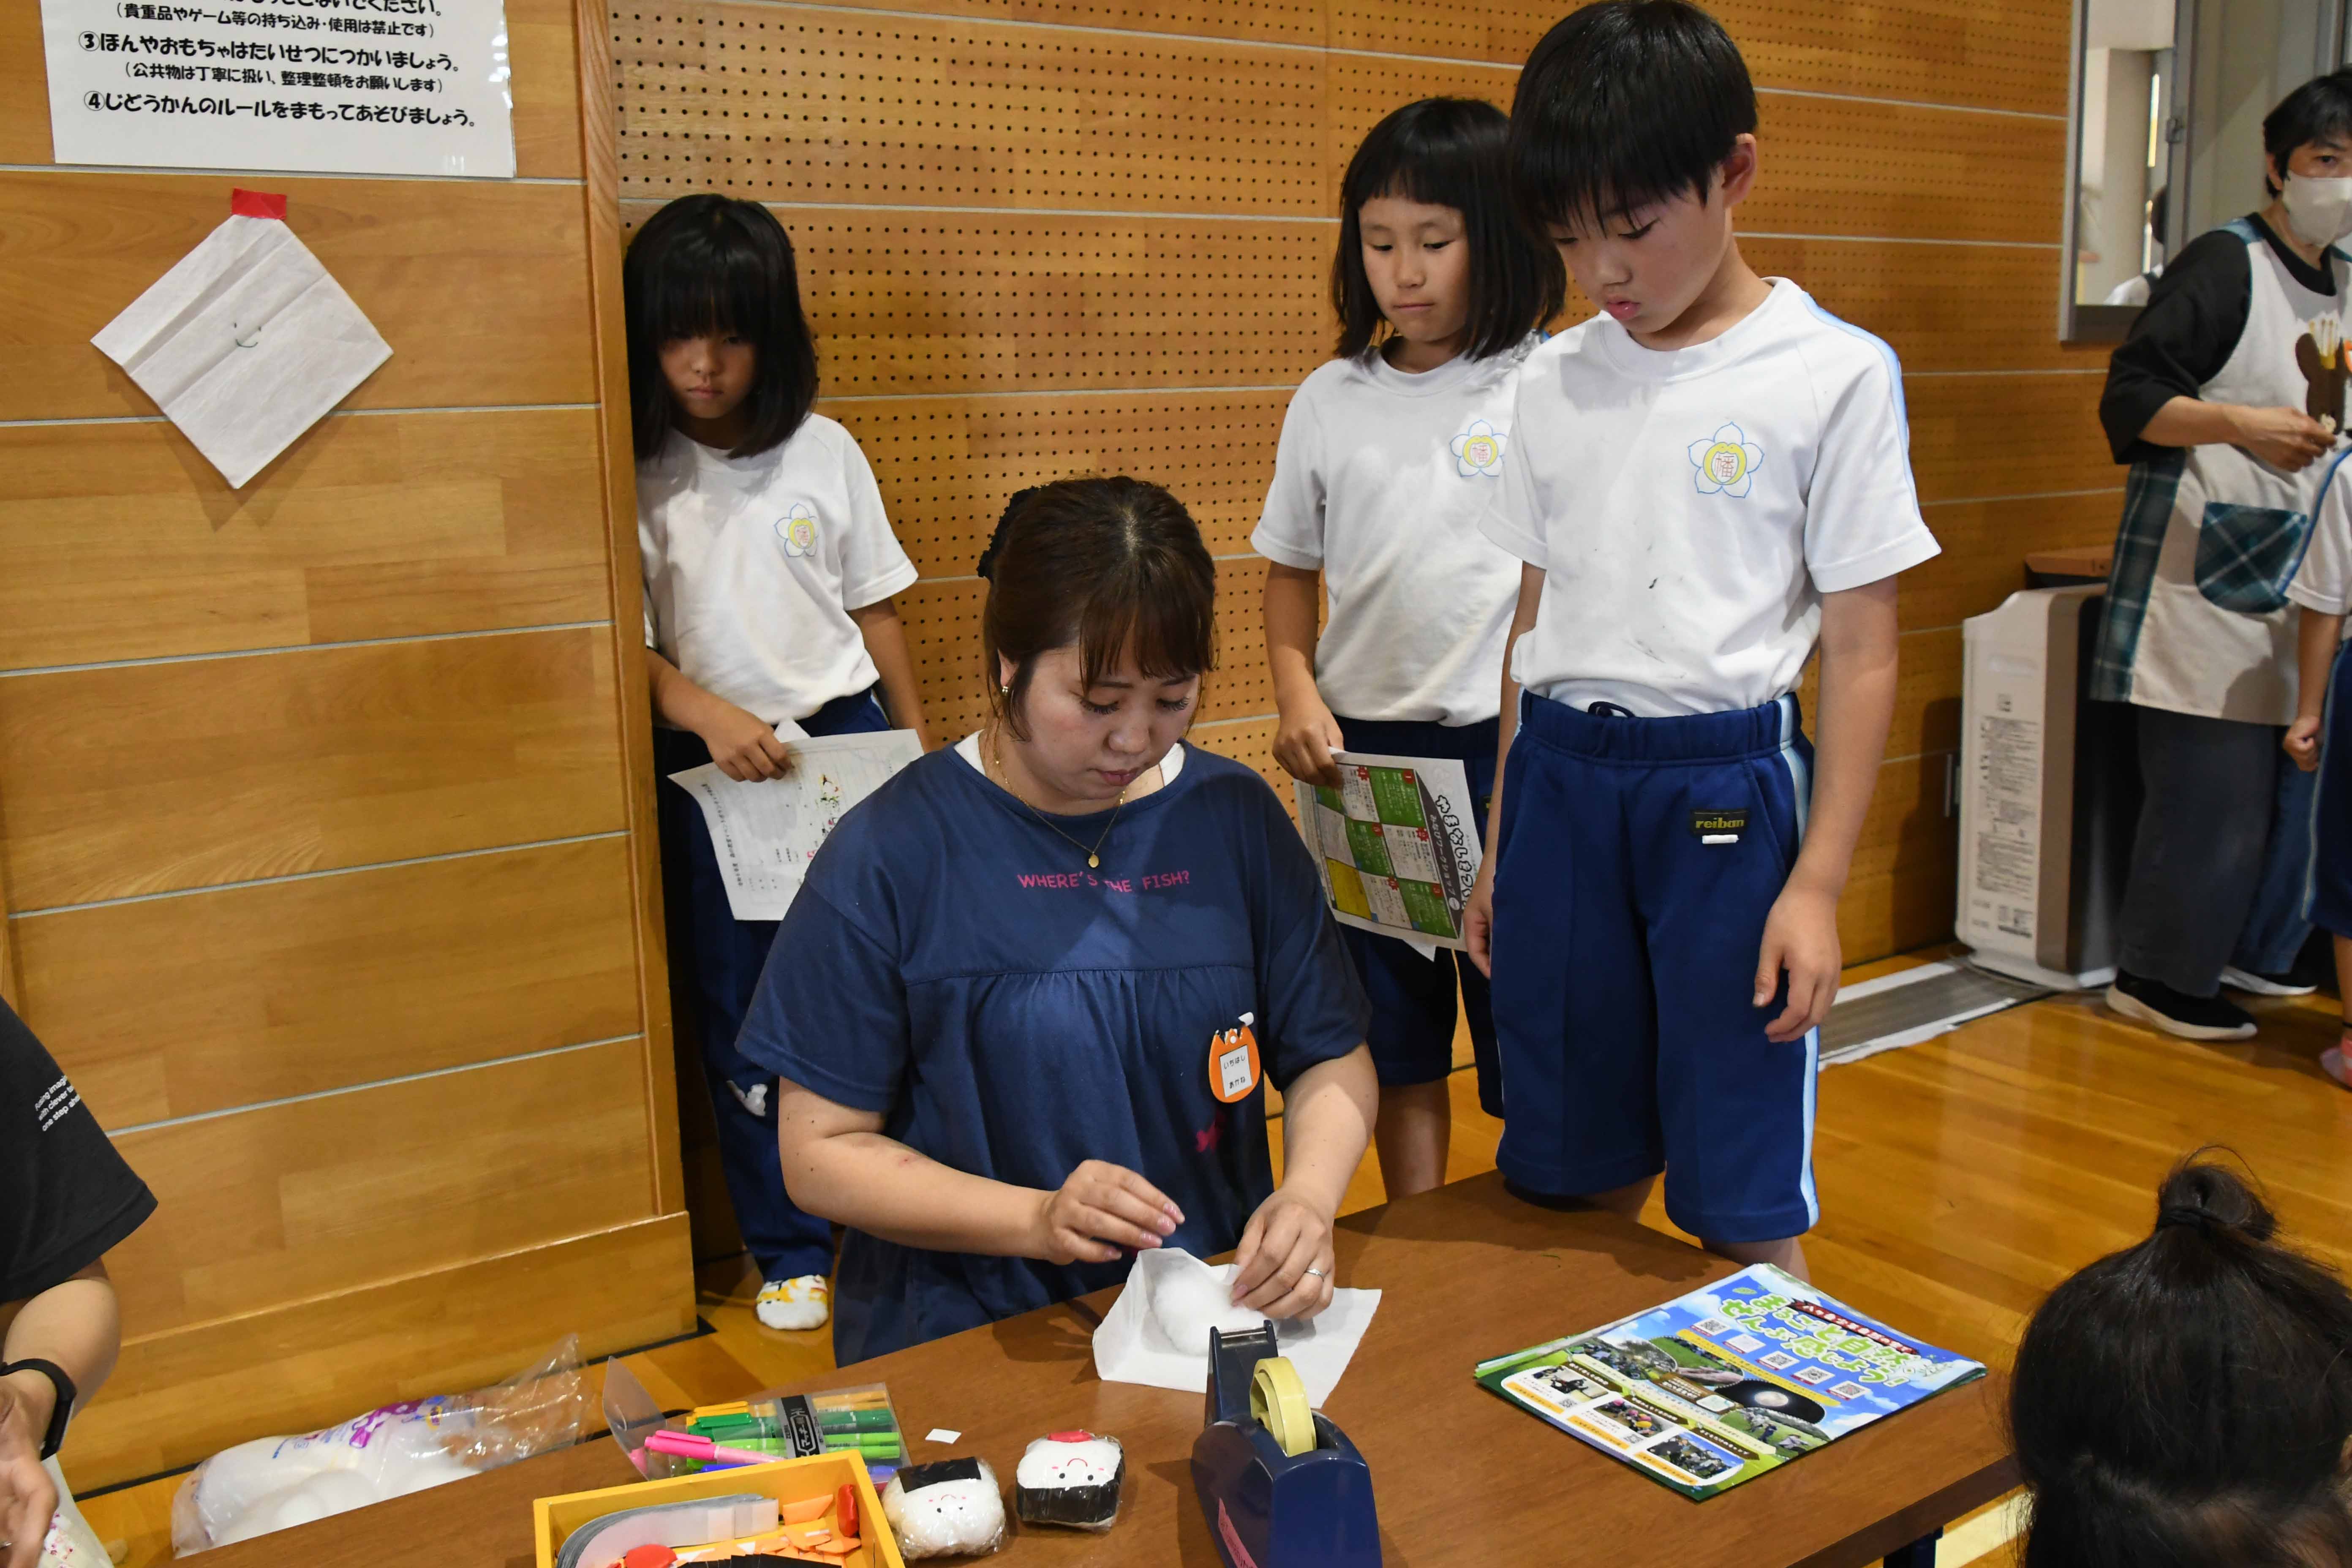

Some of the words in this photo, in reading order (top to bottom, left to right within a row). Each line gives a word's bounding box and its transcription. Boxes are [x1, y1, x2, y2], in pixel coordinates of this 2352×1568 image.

[1695, 817, 1745, 829] reiban
[1017, 871, 1098, 888] WHERE'S
[1142, 870, 1190, 890] FISH?
[53, 1105, 69, 1120] step
